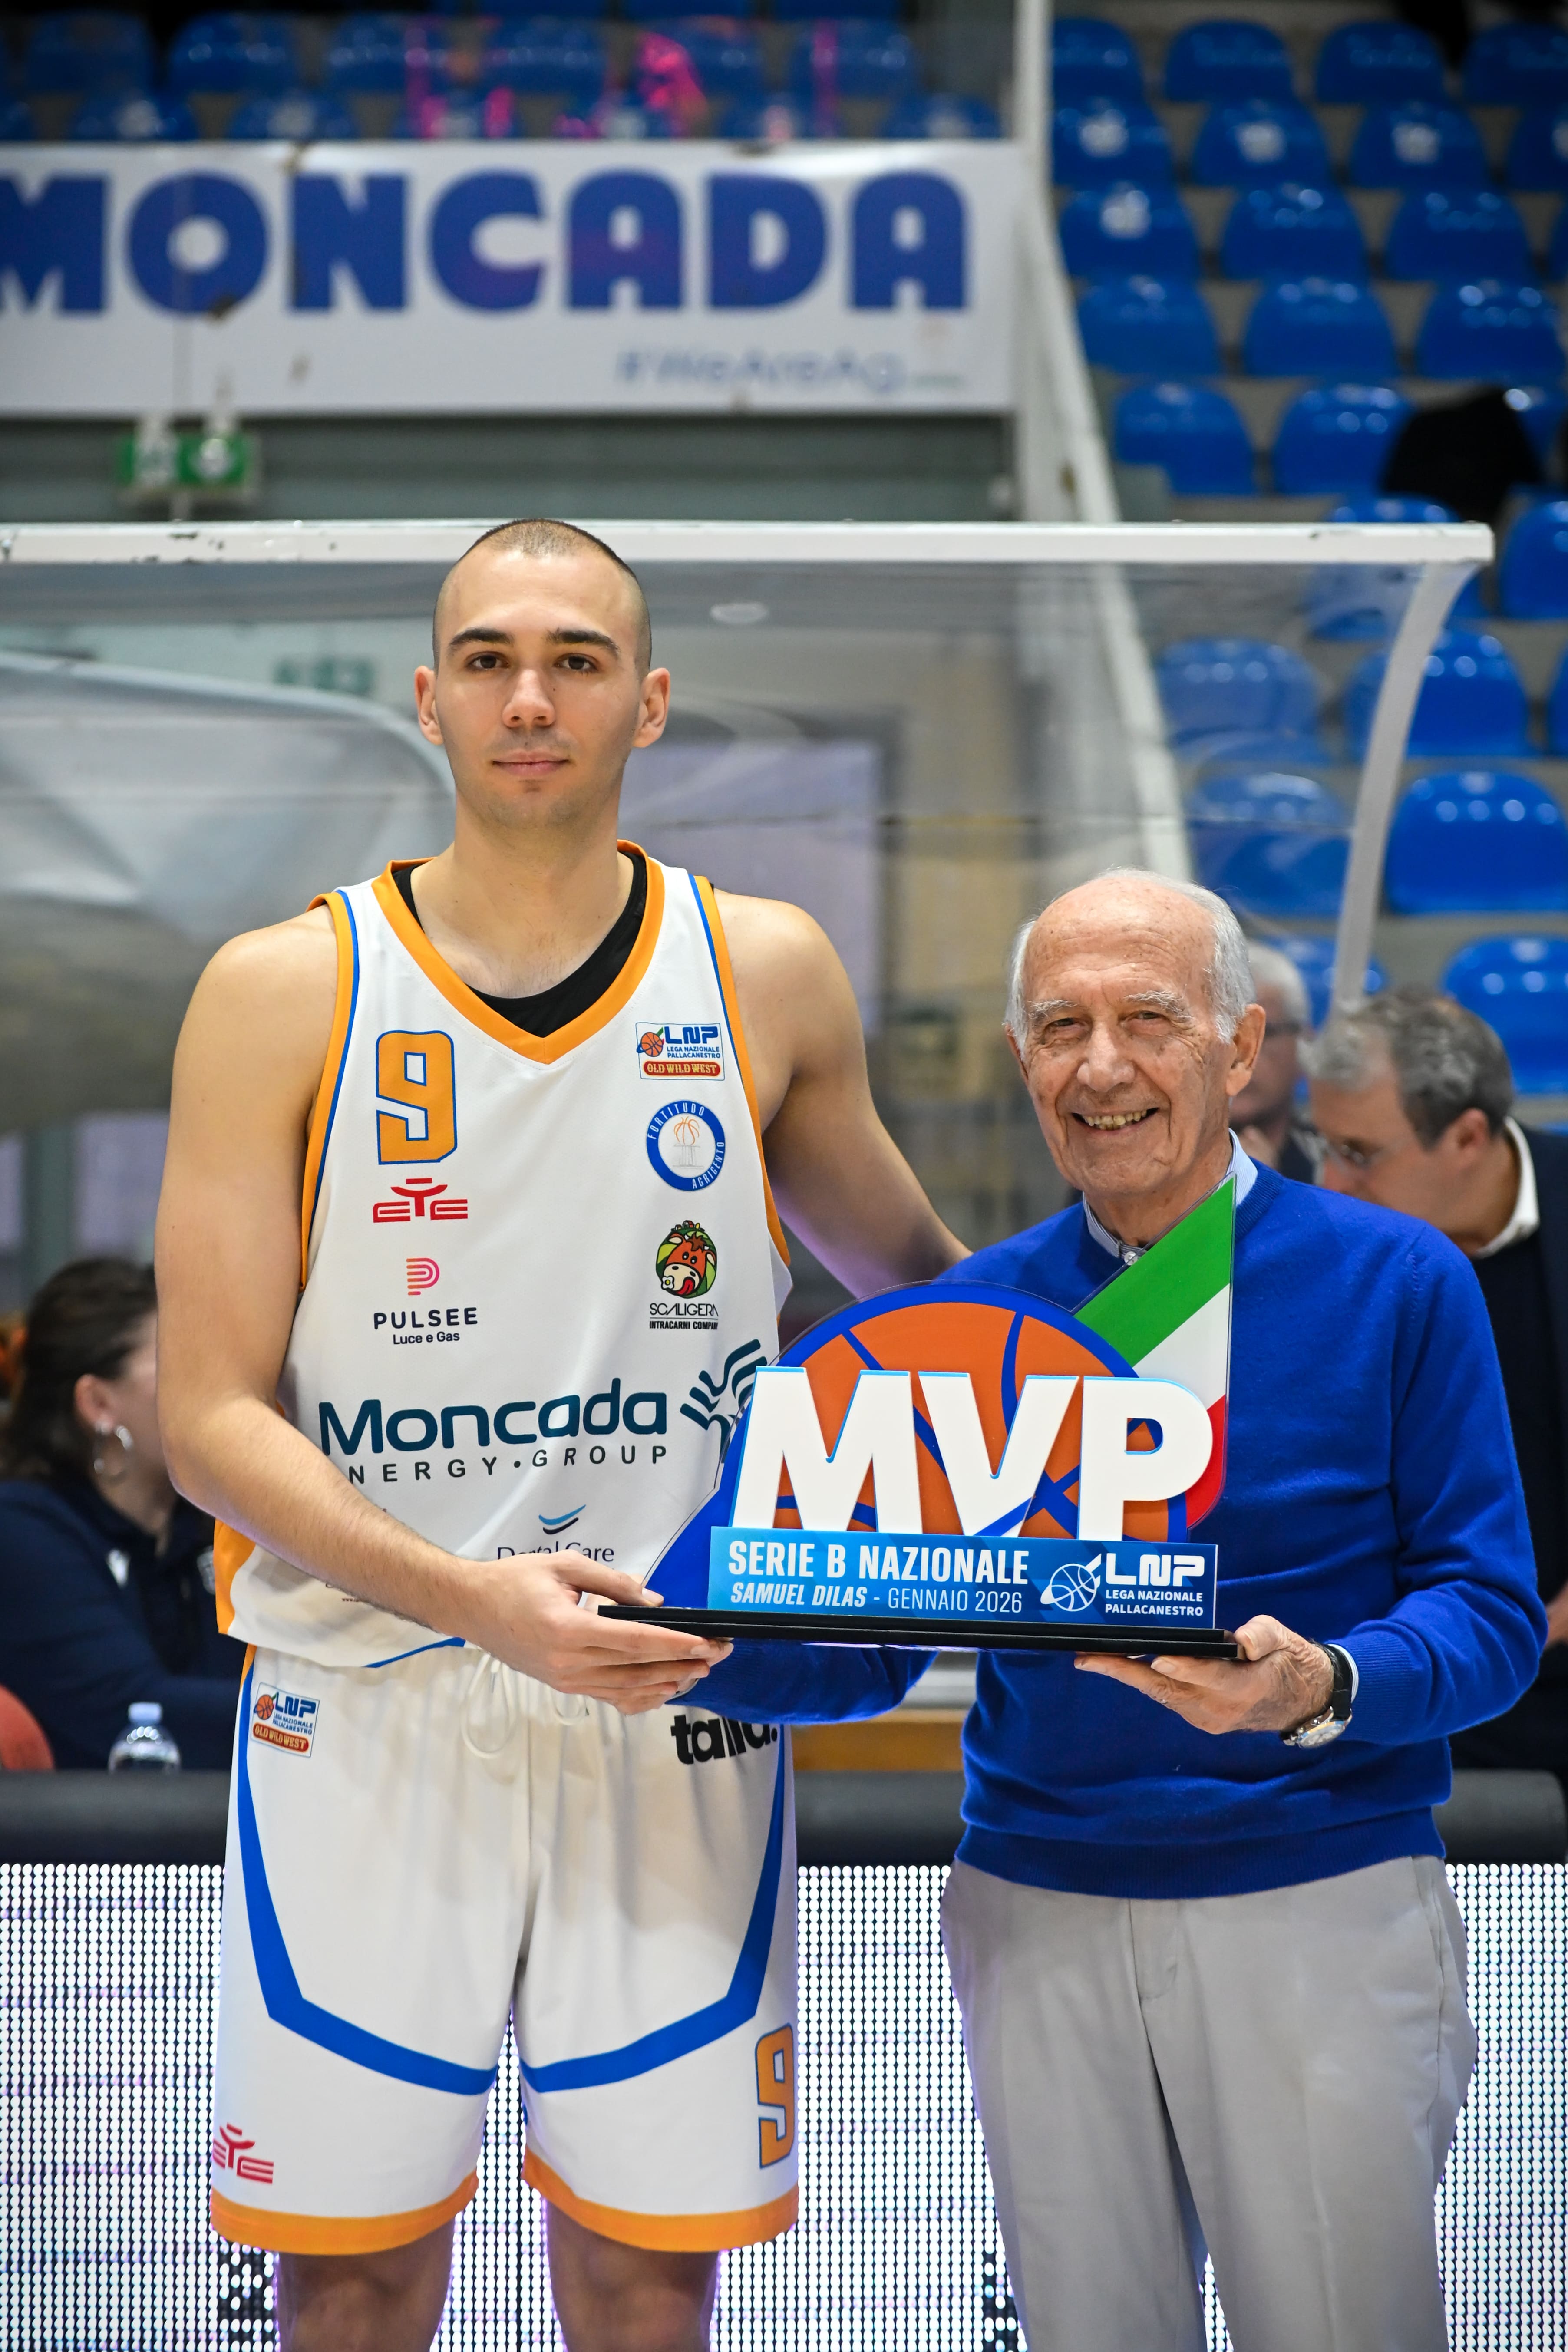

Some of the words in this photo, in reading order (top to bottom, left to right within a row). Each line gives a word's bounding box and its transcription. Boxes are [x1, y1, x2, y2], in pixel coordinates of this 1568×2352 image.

[0, 168, 969, 314] MONCADA
[664, 1026, 718, 1044] LNP
[647, 1063, 665, 1073] OLD
[666, 1064, 690, 1073] WILD
[691, 1064, 716, 1073] WEST
[376, 1030, 457, 1164] 9
[647, 1102, 704, 1139] FORTITUDO
[692, 1142, 724, 1189] AGRIGENTO
[373, 1307, 478, 1330] PULSEE
[650, 1303, 719, 1316] SCALIGERA
[393, 1334, 423, 1344] Luce
[426, 1334, 433, 1343] e
[436, 1331, 460, 1342] Gas
[650, 1321, 690, 1329] INTRACARNI
[318, 1377, 667, 1455] Moncada
[732, 1366, 1213, 1541] MVP
[349, 1457, 497, 1484] NERGY
[729, 1541, 814, 1577] SERIE
[828, 1545, 846, 1579] B
[859, 1547, 1029, 1585] NAZIONALE
[1105, 1553, 1205, 1587] LNP
[731, 1582, 805, 1606] SAMUEL
[811, 1585, 867, 1607] DILAS
[888, 1587, 967, 1612] GENNAIO
[975, 1590, 1022, 1614] 2026
[1106, 1590, 1135, 1600] LEGA
[1137, 1591, 1203, 1602] NAZIONALE
[1105, 1603, 1203, 1616] PALLACANESTRO
[275, 1692, 317, 1718] LNP
[272, 1719, 312, 1735] PALLACANESTRO
[283, 1715, 313, 1729] NAZIONALE
[255, 1725, 268, 1737] OLD
[269, 1729, 283, 1742] WILD
[284, 1735, 306, 1750] WEST
[755, 2022, 795, 2168] 9
